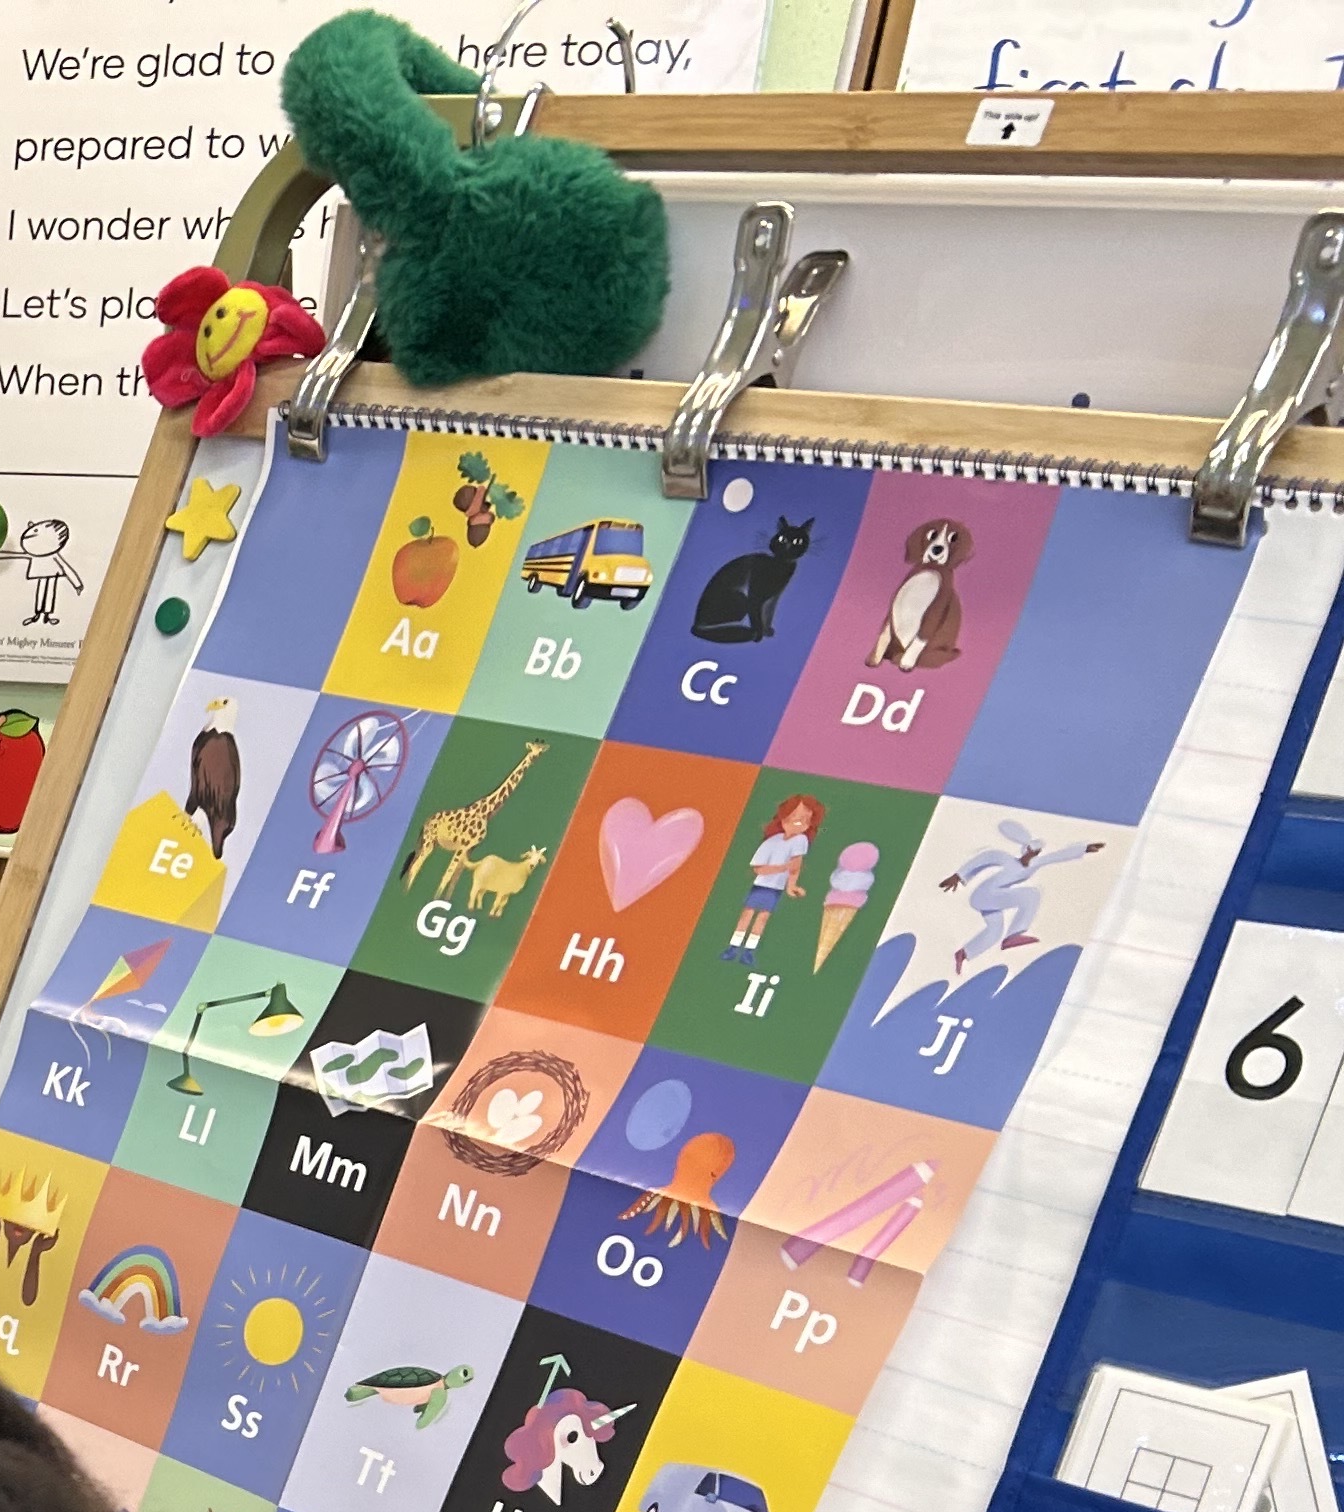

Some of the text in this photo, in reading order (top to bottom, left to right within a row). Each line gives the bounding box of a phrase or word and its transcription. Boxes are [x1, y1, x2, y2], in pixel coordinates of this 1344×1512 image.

[22, 29, 692, 86] We're glad to here today,
[14, 128, 192, 170] prepared
[206, 128, 245, 160] to
[8, 210, 16, 240] I
[28, 210, 171, 241] wonder
[2, 288, 89, 321] Let's
[7, 636, 36, 649] Mighty
[381, 618, 439, 660] Aa
[524, 637, 582, 679] Bb
[681, 660, 738, 705] Cc
[841, 683, 925, 733] Dd
[148, 838, 194, 878] Ee
[286, 869, 336, 909] Ff
[416, 900, 476, 956] Gg
[559, 933, 626, 983] Hh
[733, 972, 780, 1018] Ii
[919, 1014, 973, 1075] Jj
[1225, 995, 1305, 1101] 6
[41, 1062, 92, 1107] Kk
[178, 1105, 217, 1146] Ll
[289, 1135, 368, 1192] Mm
[437, 1183, 501, 1236] Nn
[596, 1235, 664, 1287] Oo
[769, 1289, 837, 1353] Pp
[97, 1344, 140, 1388] Rr
[220, 1394, 263, 1439] Ss
[356, 1446, 396, 1494] Tt
